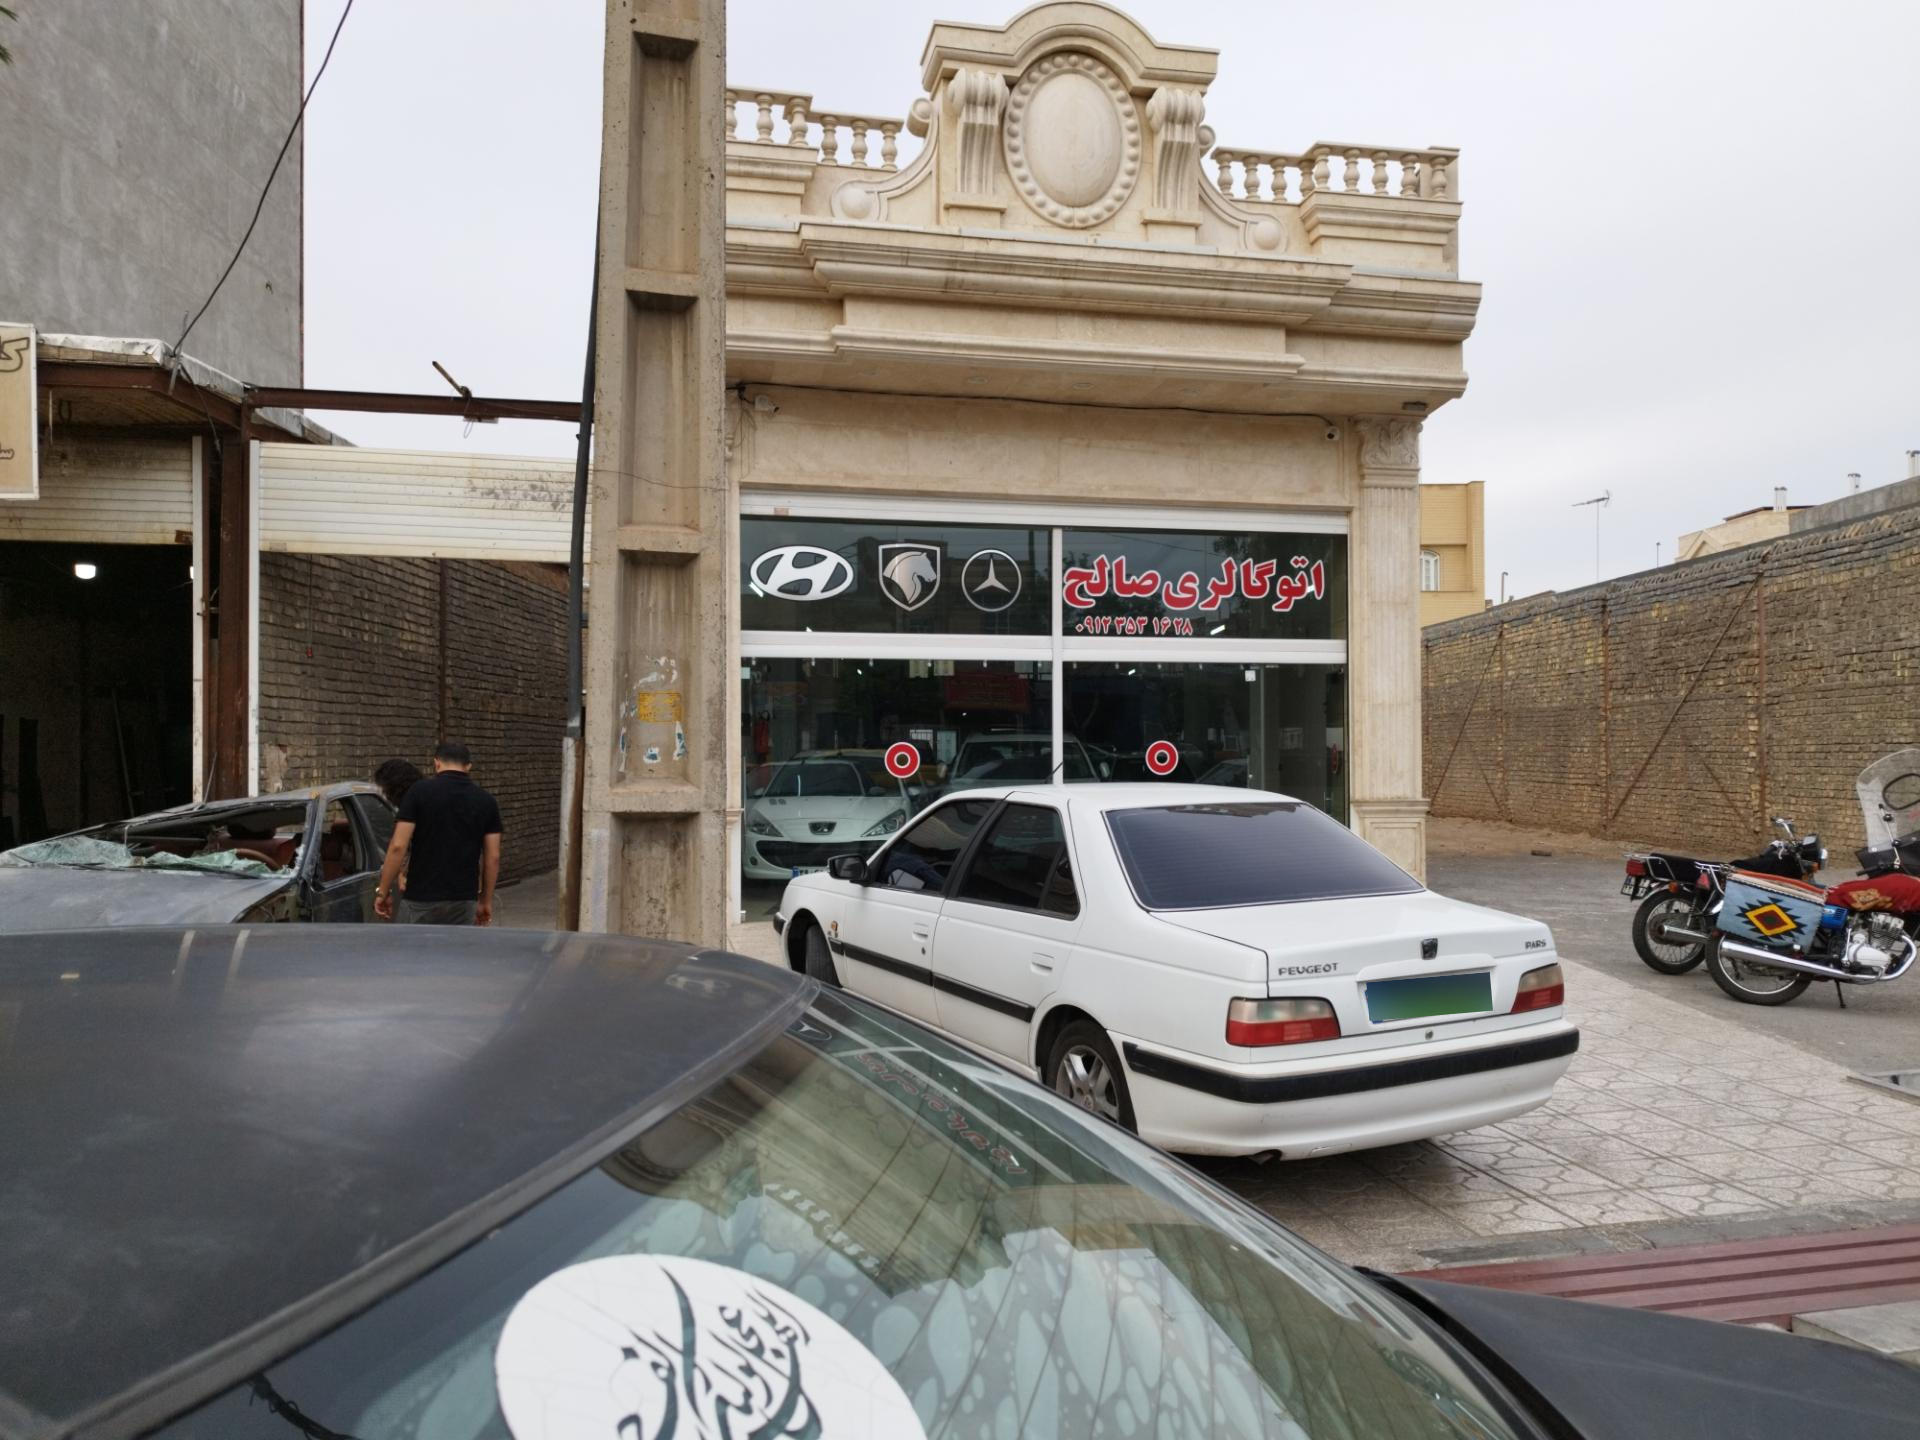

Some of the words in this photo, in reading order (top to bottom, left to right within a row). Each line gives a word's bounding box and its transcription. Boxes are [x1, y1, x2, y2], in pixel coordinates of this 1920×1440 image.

[1062, 554, 1162, 608] صالح
[1525, 939, 1547, 950] PARS
[1278, 962, 1339, 976] PEUGEOT
